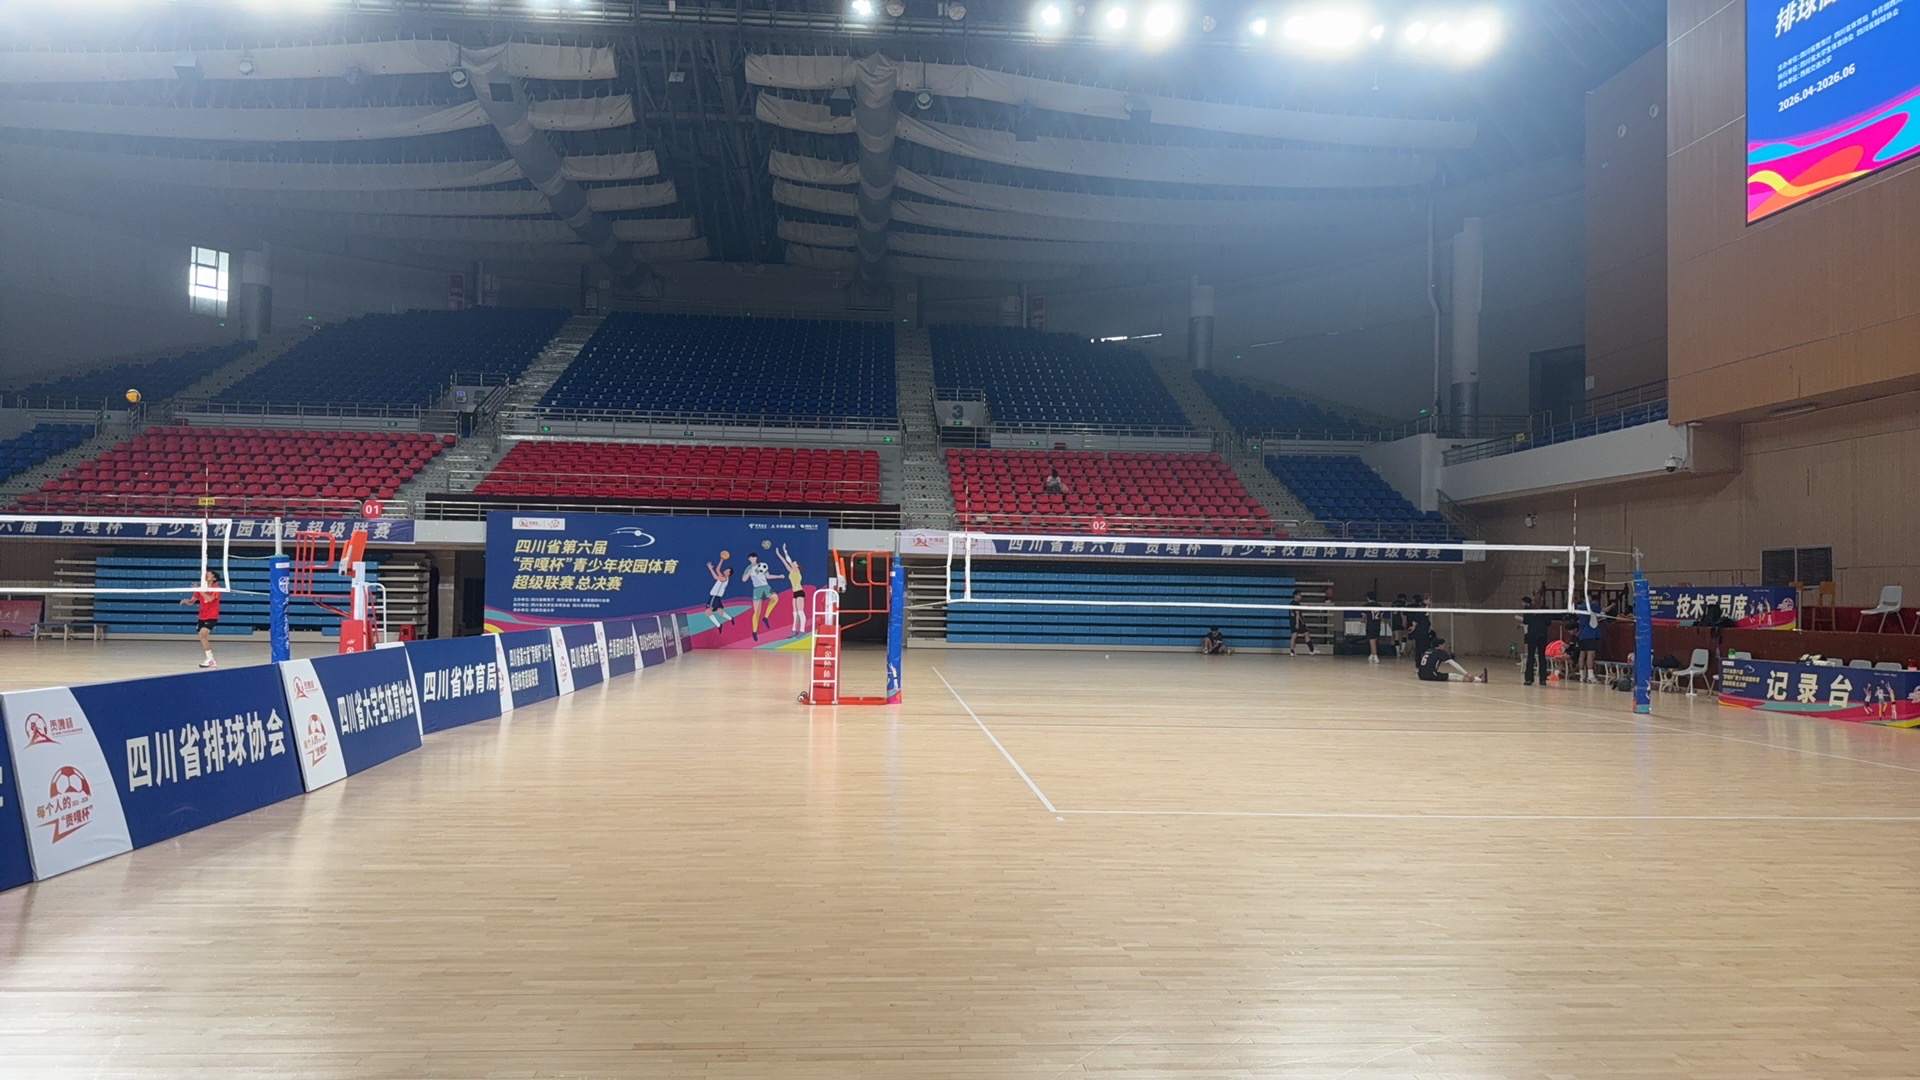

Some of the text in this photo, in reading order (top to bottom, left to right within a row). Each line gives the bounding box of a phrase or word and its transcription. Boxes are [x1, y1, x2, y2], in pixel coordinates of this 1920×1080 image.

[1778, 63, 1856, 112] 2026.04-2026.06
[952, 405, 964, 419] 3
[364, 504, 380, 515] 01
[1092, 521, 1106, 531] 02
[514, 539, 608, 555] 四川省第六届
[1420, 655, 1429, 665] 6
[423, 662, 497, 703] 四川省体育局
[1766, 670, 1853, 708] 记录台
[336, 679, 415, 736] 四川省大学生体育协会
[126, 708, 286, 793] 四川省排球协会
[36, 796, 72, 819] 每个人的
